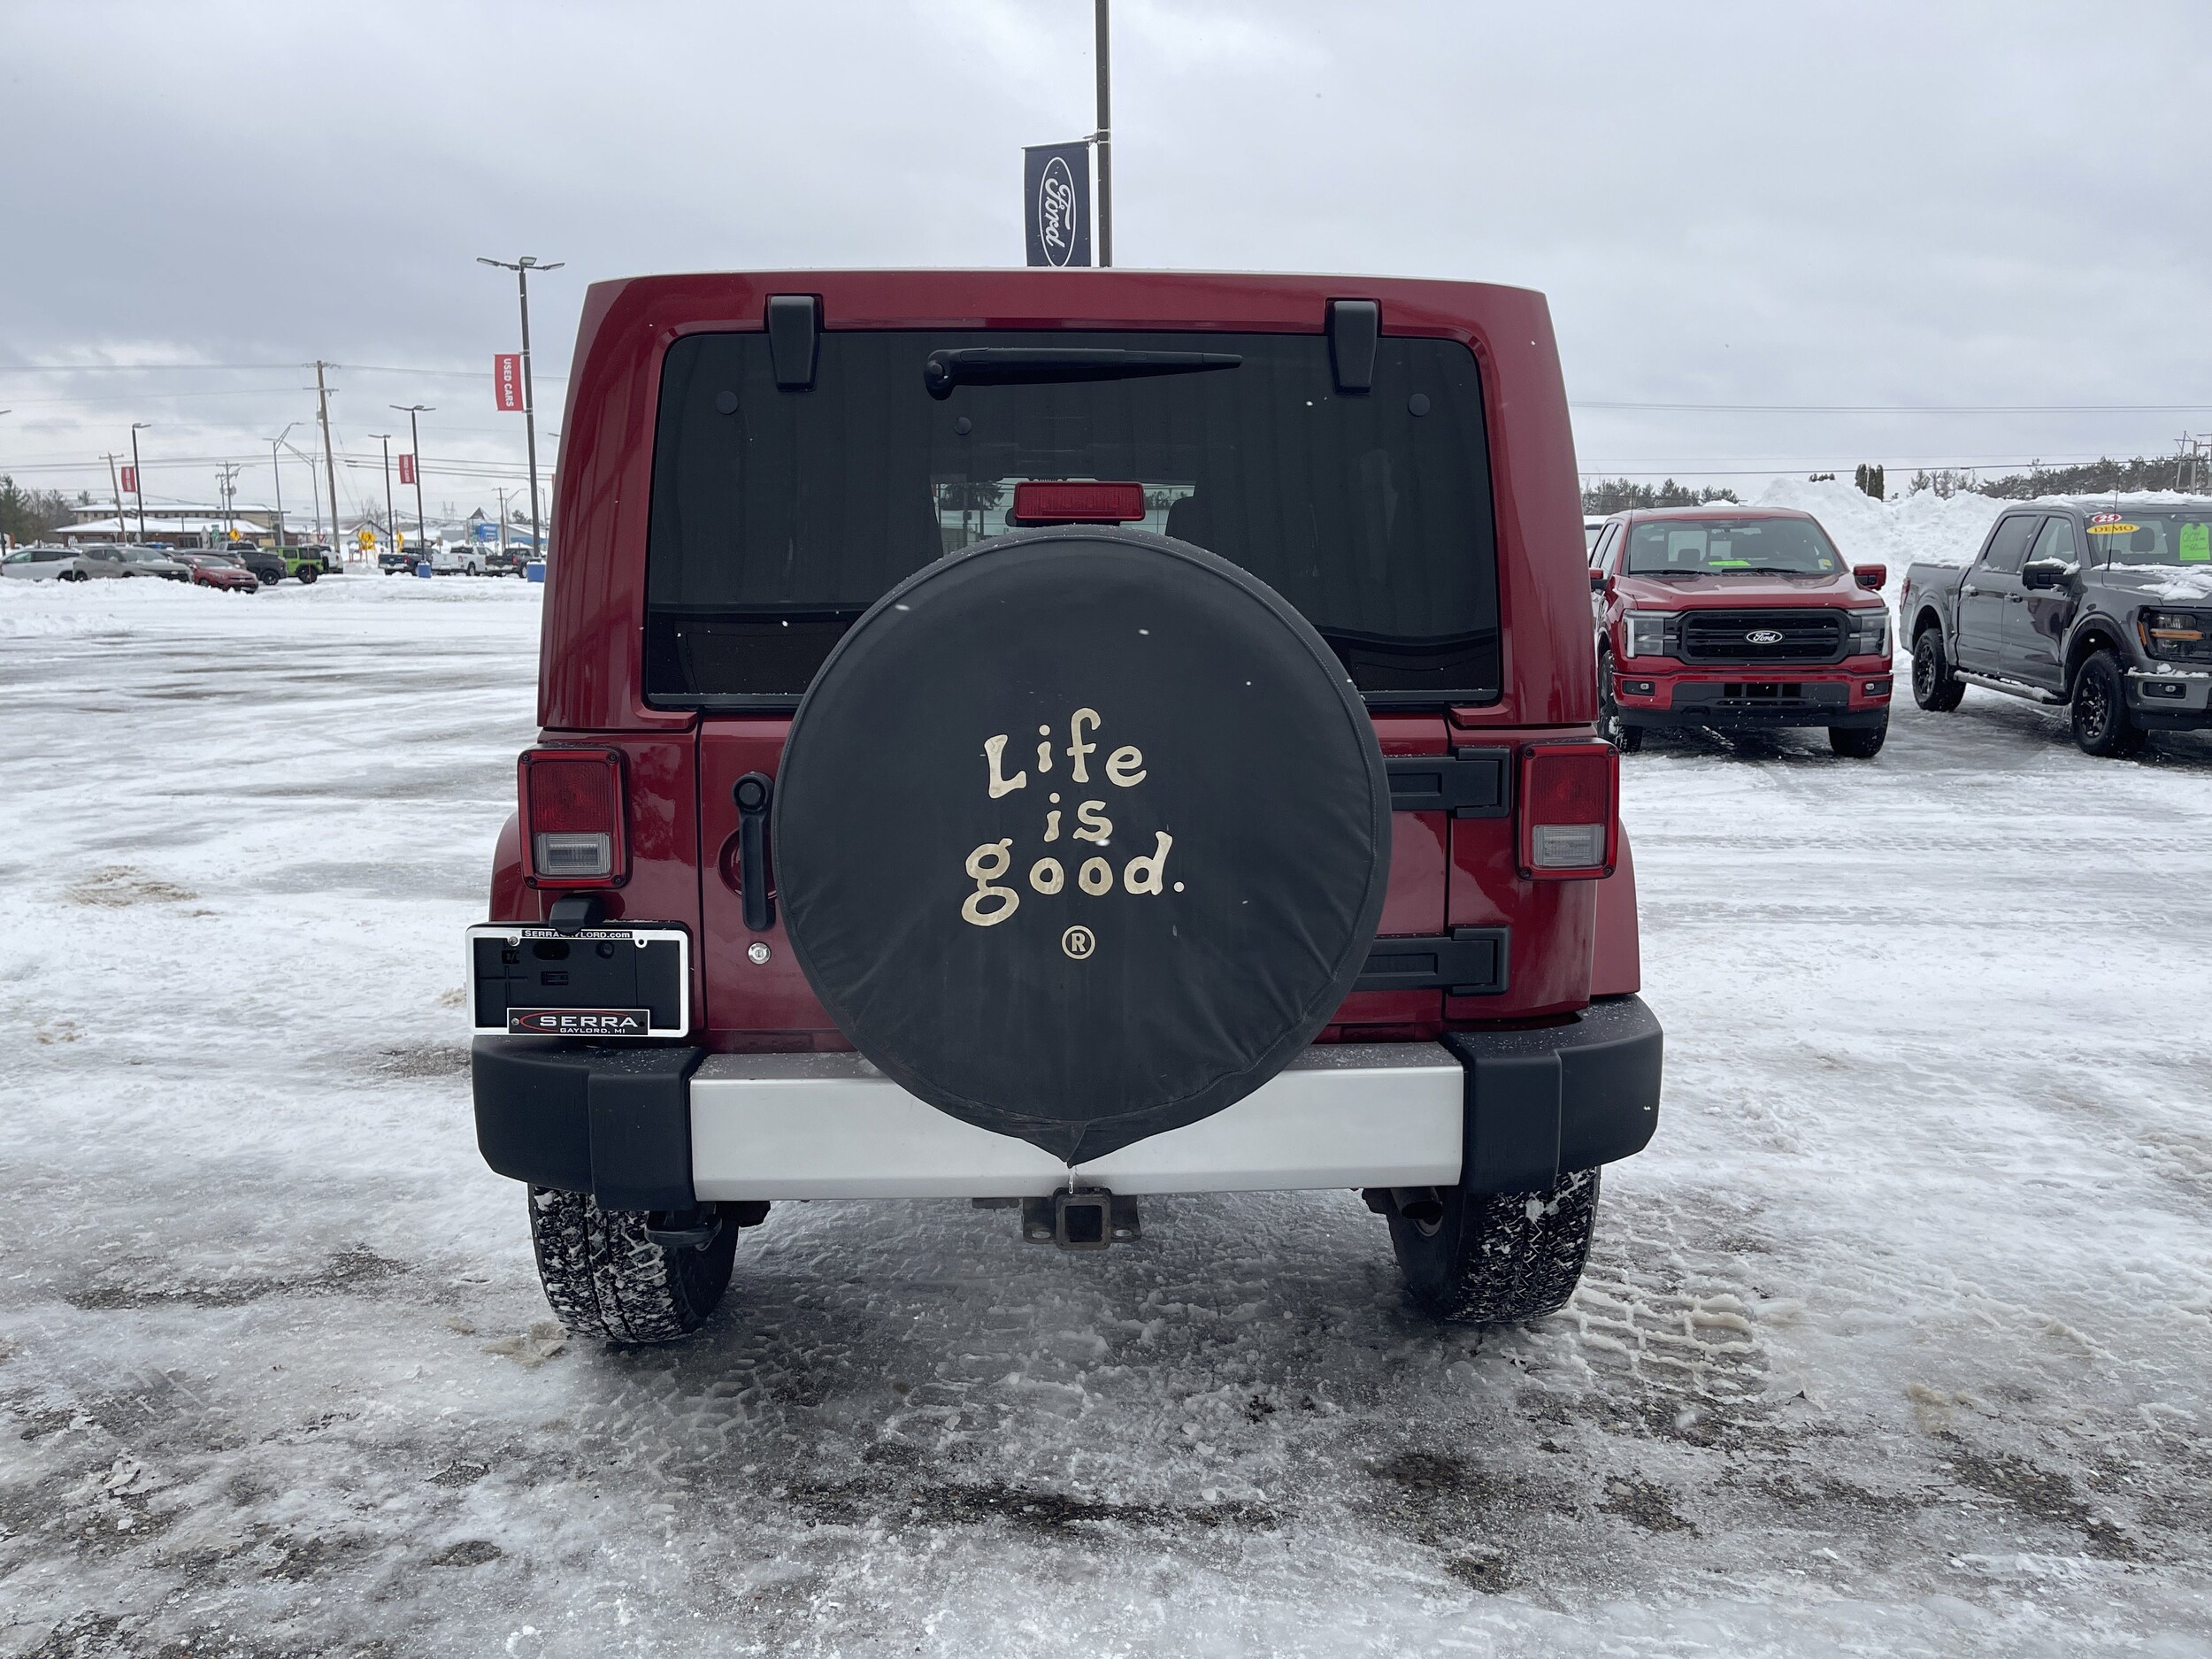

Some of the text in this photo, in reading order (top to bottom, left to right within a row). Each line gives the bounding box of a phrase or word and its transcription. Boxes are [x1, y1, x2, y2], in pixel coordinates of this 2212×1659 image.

[1044, 178, 1071, 248] Ford
[504, 383, 514, 407] CARS
[1753, 632, 1776, 641] Ford
[984, 707, 1147, 799] Life
[1044, 792, 1113, 842] is
[961, 830, 1185, 926] good.
[540, 1016, 638, 1027] SERRA
